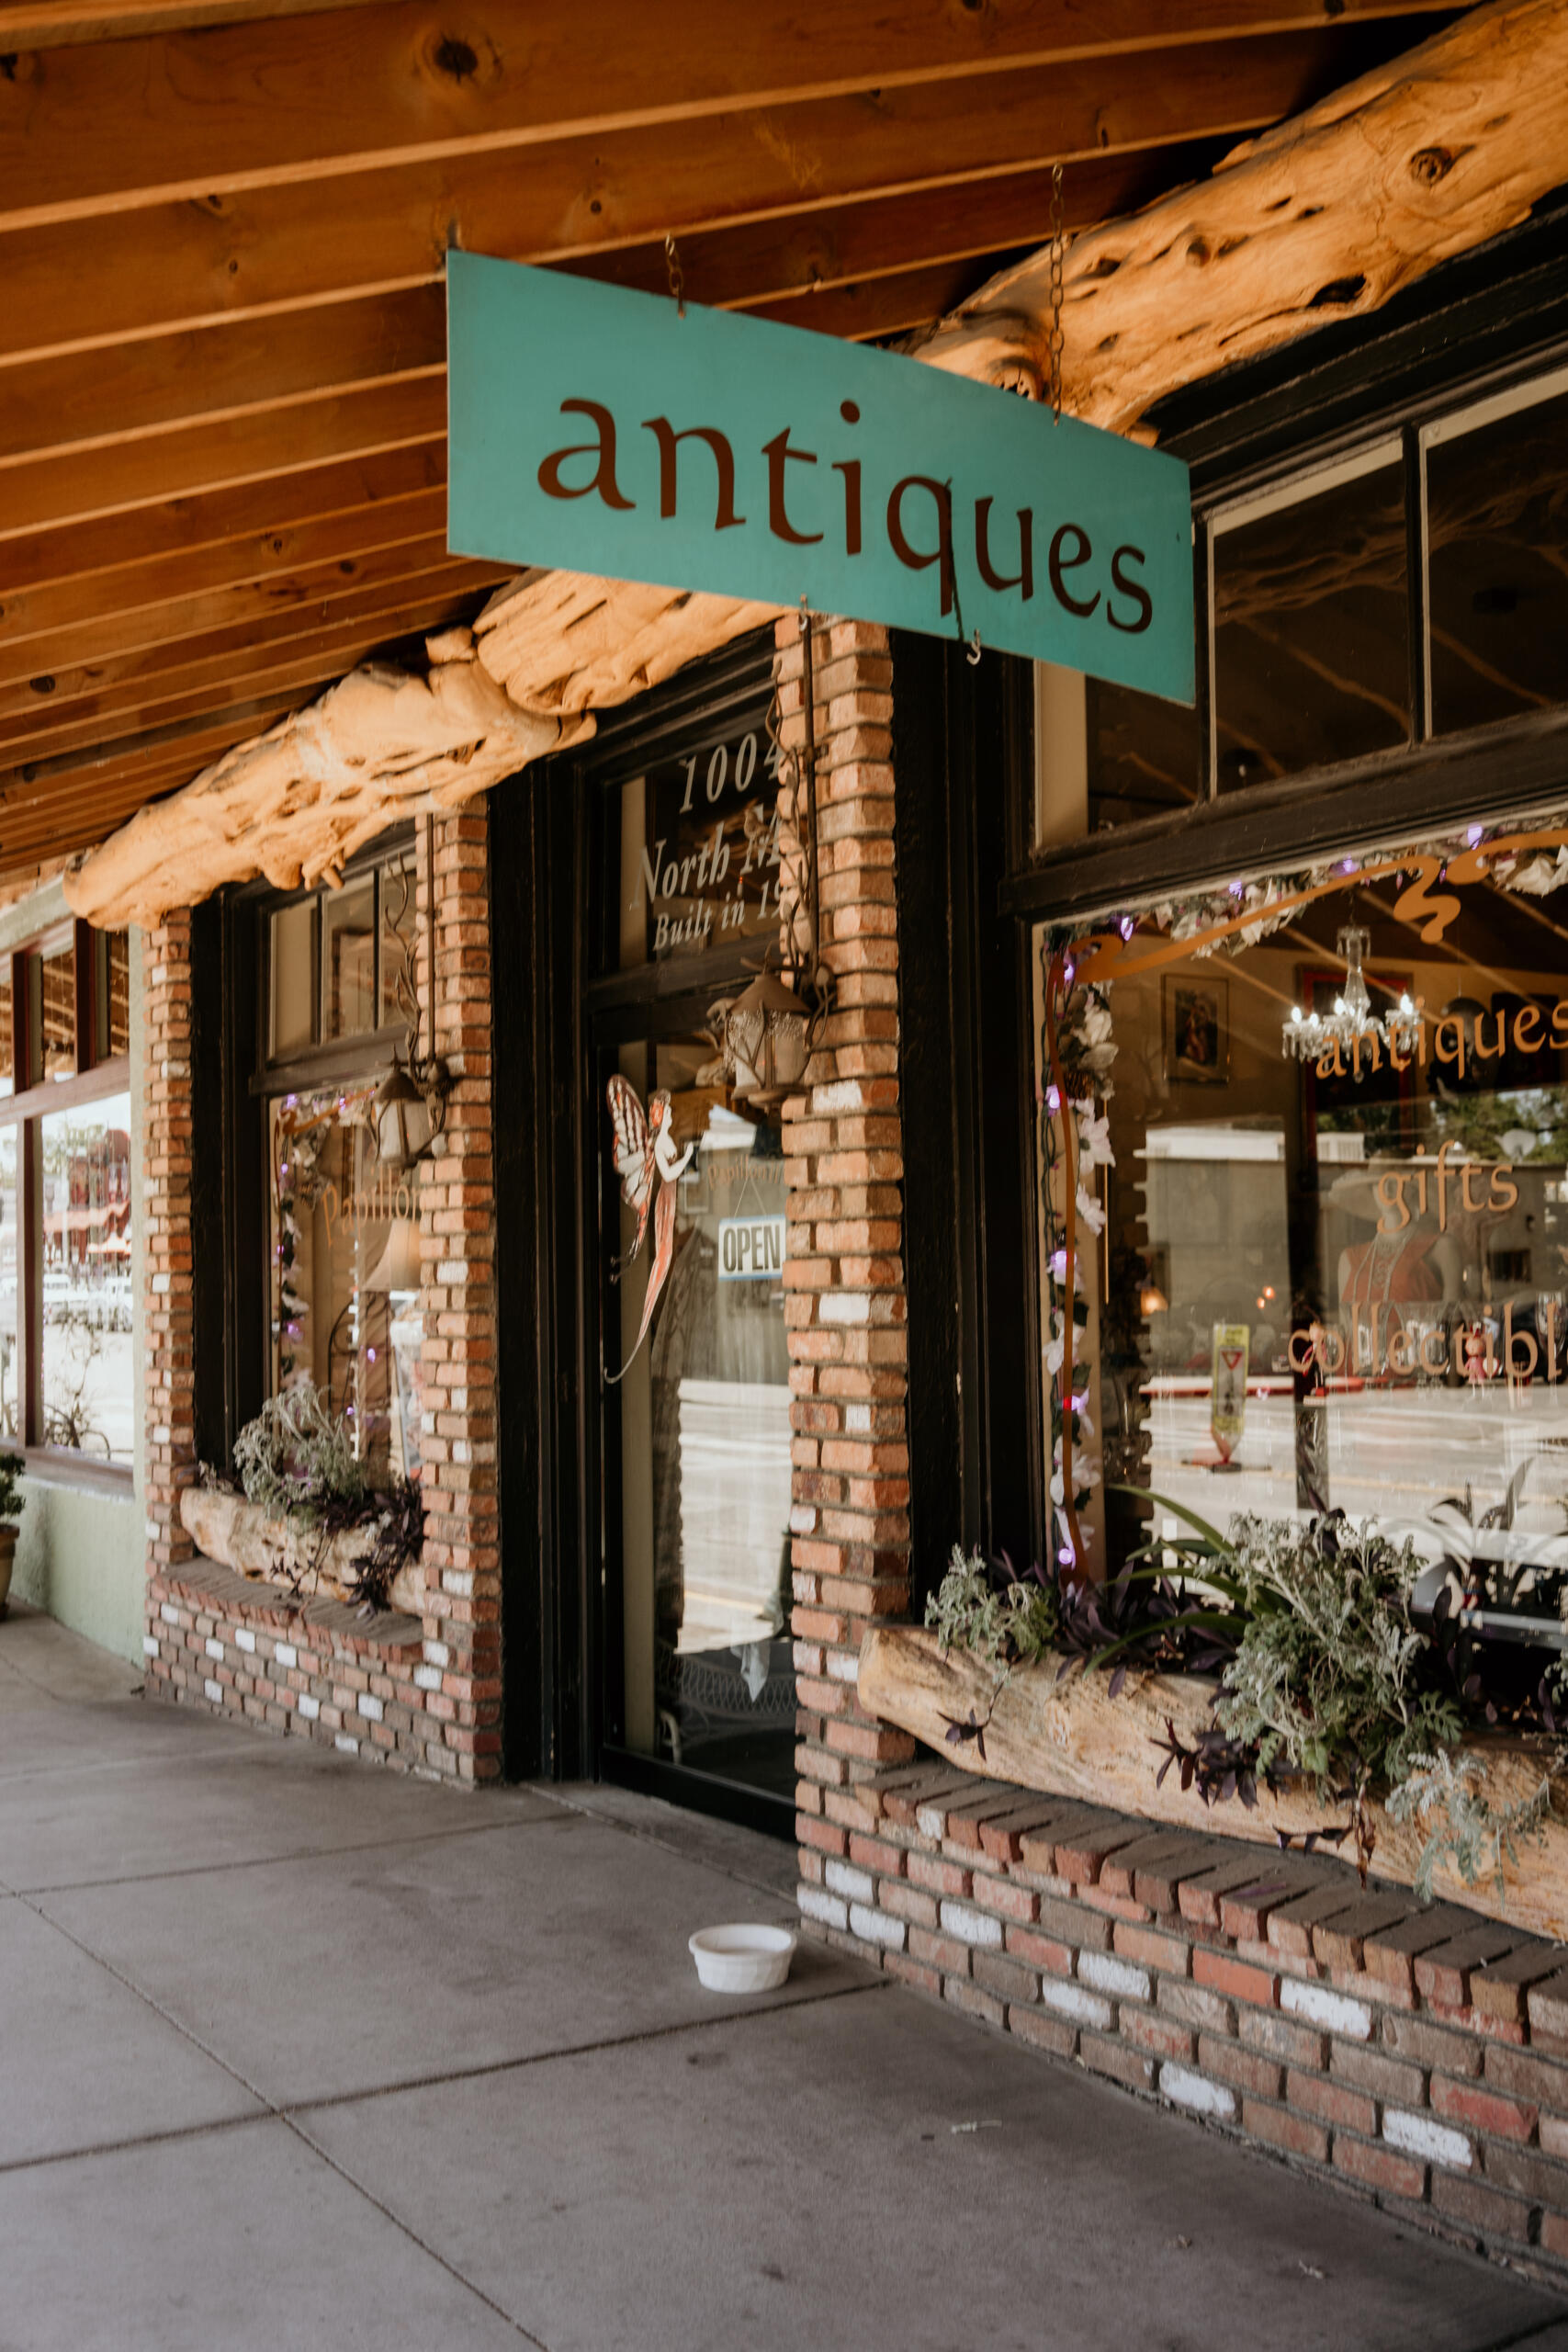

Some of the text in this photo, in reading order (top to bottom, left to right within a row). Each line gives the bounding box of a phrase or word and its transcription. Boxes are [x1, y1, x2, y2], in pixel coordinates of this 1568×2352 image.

[537, 398, 1154, 634] antiques
[632, 820, 730, 908] North
[652, 898, 713, 952] Built
[721, 891, 745, 932] in
[1315, 995, 1568, 1080] antiques
[1376, 1139, 1519, 1234] gifts
[723, 1224, 781, 1272] OPEN
[1288, 1300, 1568, 1382] collectibl
